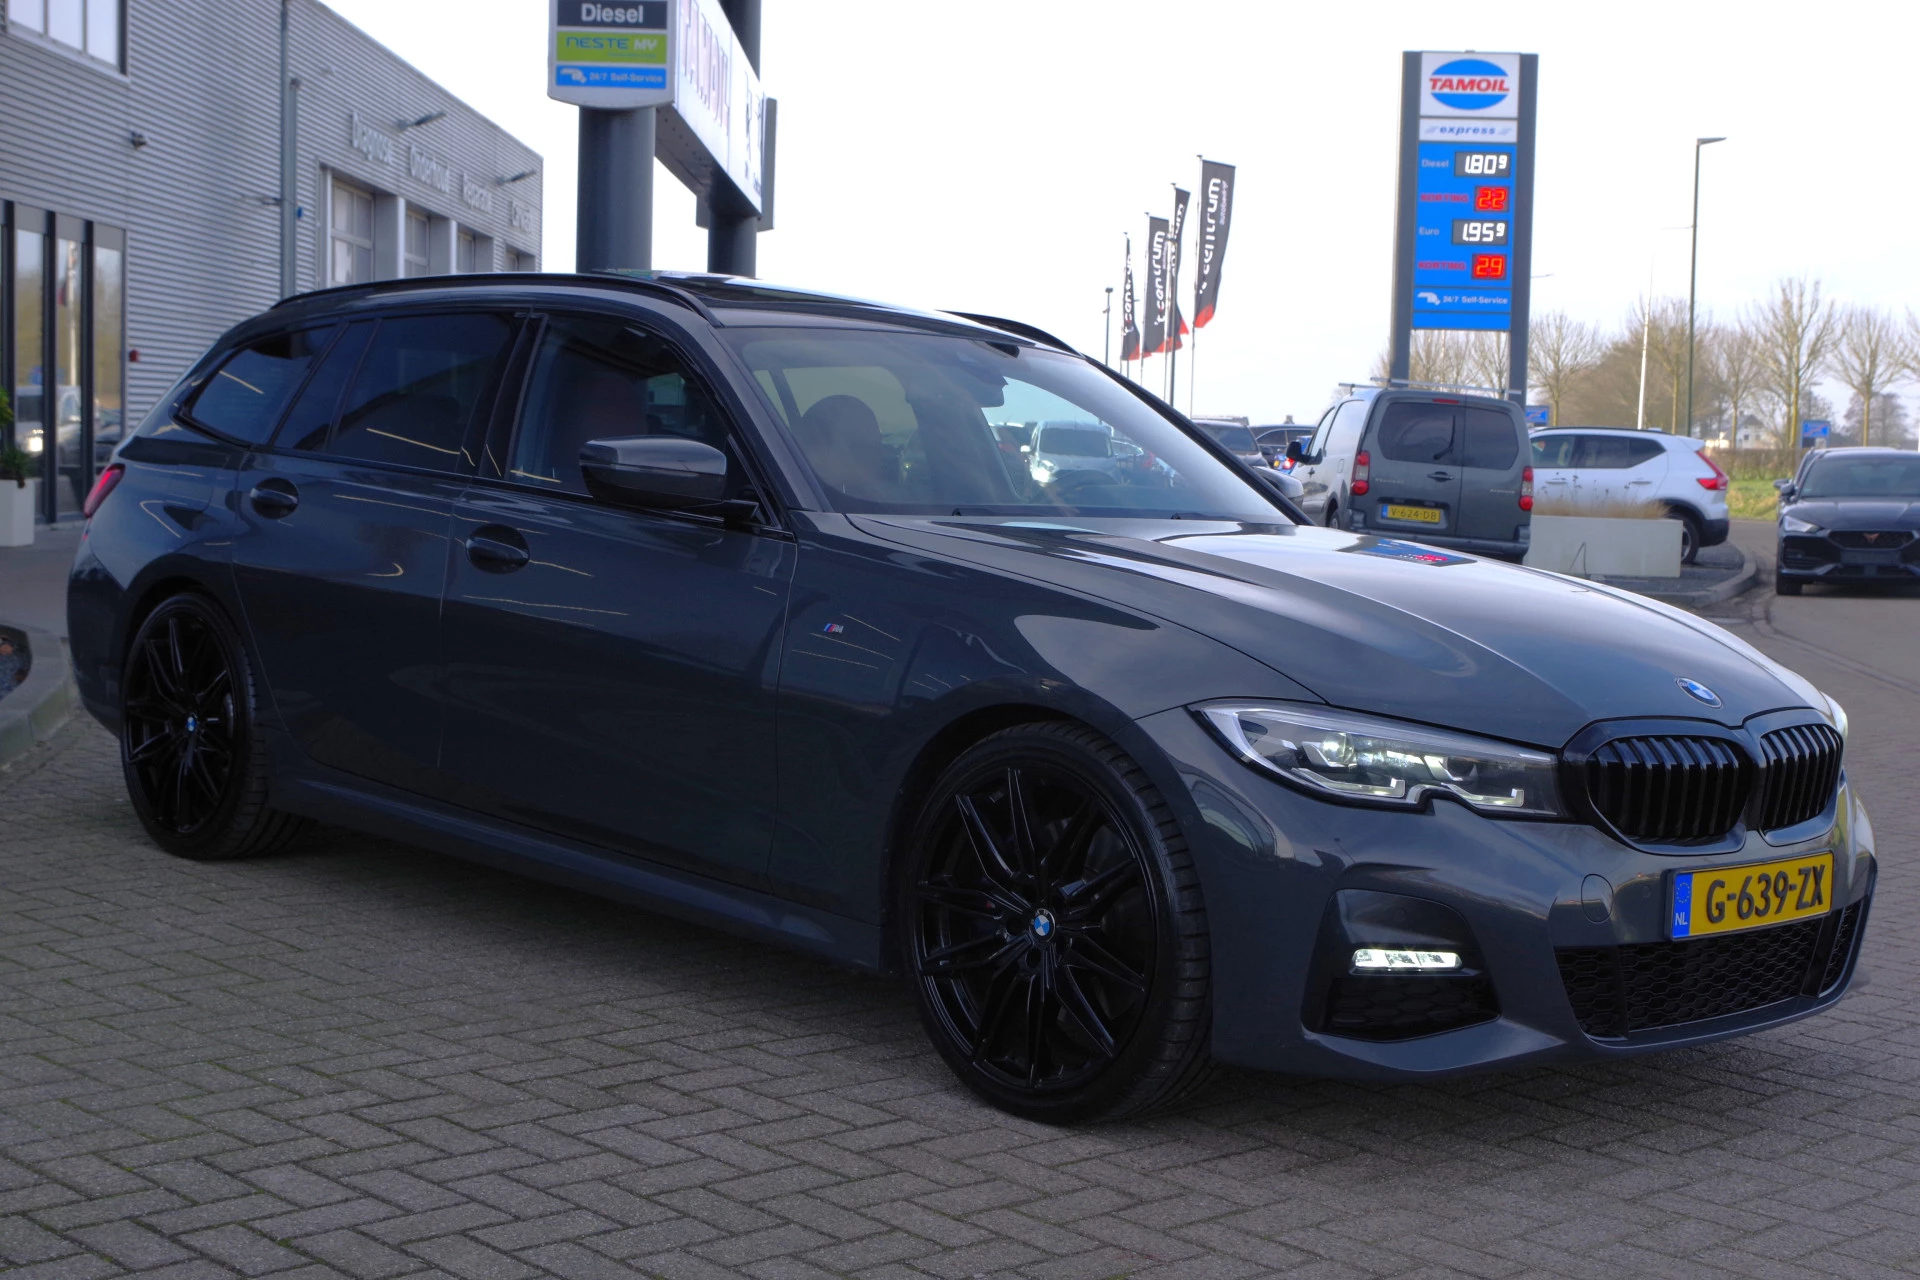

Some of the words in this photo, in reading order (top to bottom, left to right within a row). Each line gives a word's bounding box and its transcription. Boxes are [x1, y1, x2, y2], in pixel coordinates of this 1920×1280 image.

[581, 2, 645, 23] Diesel
[566, 36, 629, 51] NESTE
[610, 72, 663, 84] Self-Service
[1429, 77, 1510, 93] TAMOIL
[1439, 124, 1496, 137] express
[1421, 158, 1449, 169] Diesel
[1476, 187, 1507, 210] 22
[1418, 226, 1440, 237] Euro
[1152, 231, 1166, 311] centrum
[1473, 254, 1505, 277] 29
[1461, 295, 1508, 305] Self-Service
[1391, 507, 1437, 520] V-624-DB
[1706, 864, 1826, 924] G-639-ZX
[1674, 911, 1688, 926] NL
